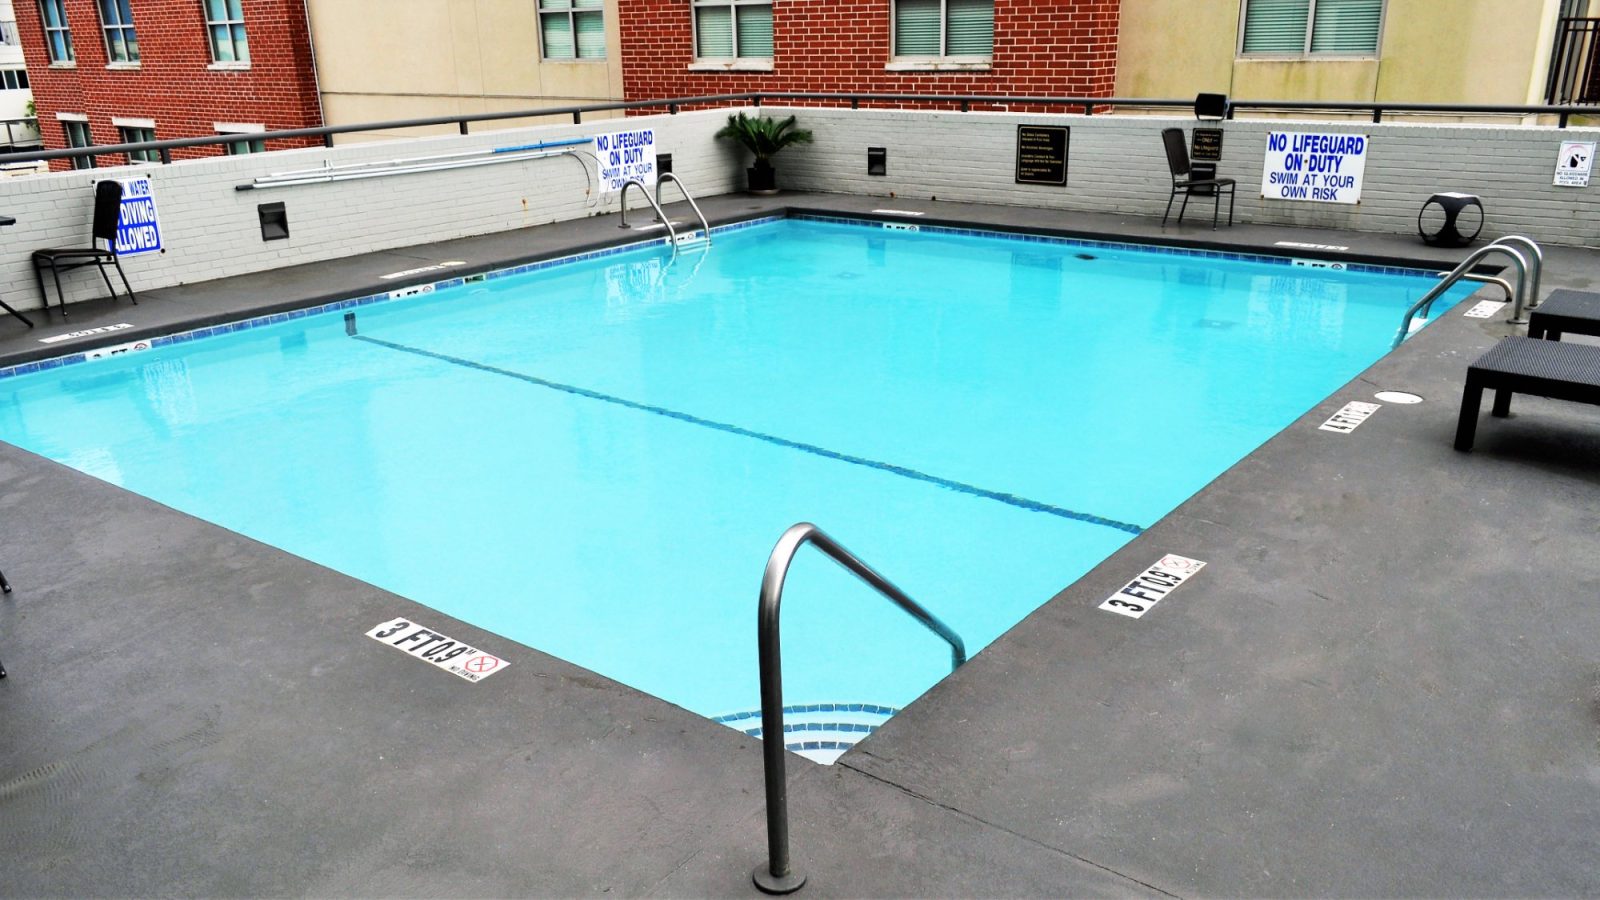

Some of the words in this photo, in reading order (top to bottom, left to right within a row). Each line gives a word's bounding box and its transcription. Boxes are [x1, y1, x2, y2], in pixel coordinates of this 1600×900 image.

[597, 135, 609, 151] NO
[611, 130, 653, 150] LIFEGUARD
[1268, 133, 1287, 152] NO
[1292, 134, 1364, 155] LIFEGUARD
[609, 150, 621, 166] ON
[623, 148, 644, 164] DUTY
[1284, 153, 1303, 171] ON
[1308, 154, 1343, 173] DUTY
[602, 167, 620, 180] SWIM
[623, 165, 631, 176] AT
[634, 162, 653, 174] YOUR
[1269, 171, 1298, 185] SWIM
[1302, 173, 1318, 186] AT
[1323, 174, 1355, 189] YOUR
[128, 179, 149, 196] WATER
[1280, 185, 1307, 199] OWN
[1312, 187, 1338, 201] RISK
[120, 199, 155, 226] DIVING
[1108, 599, 1145, 612] 3
[375, 621, 411, 639] 3
